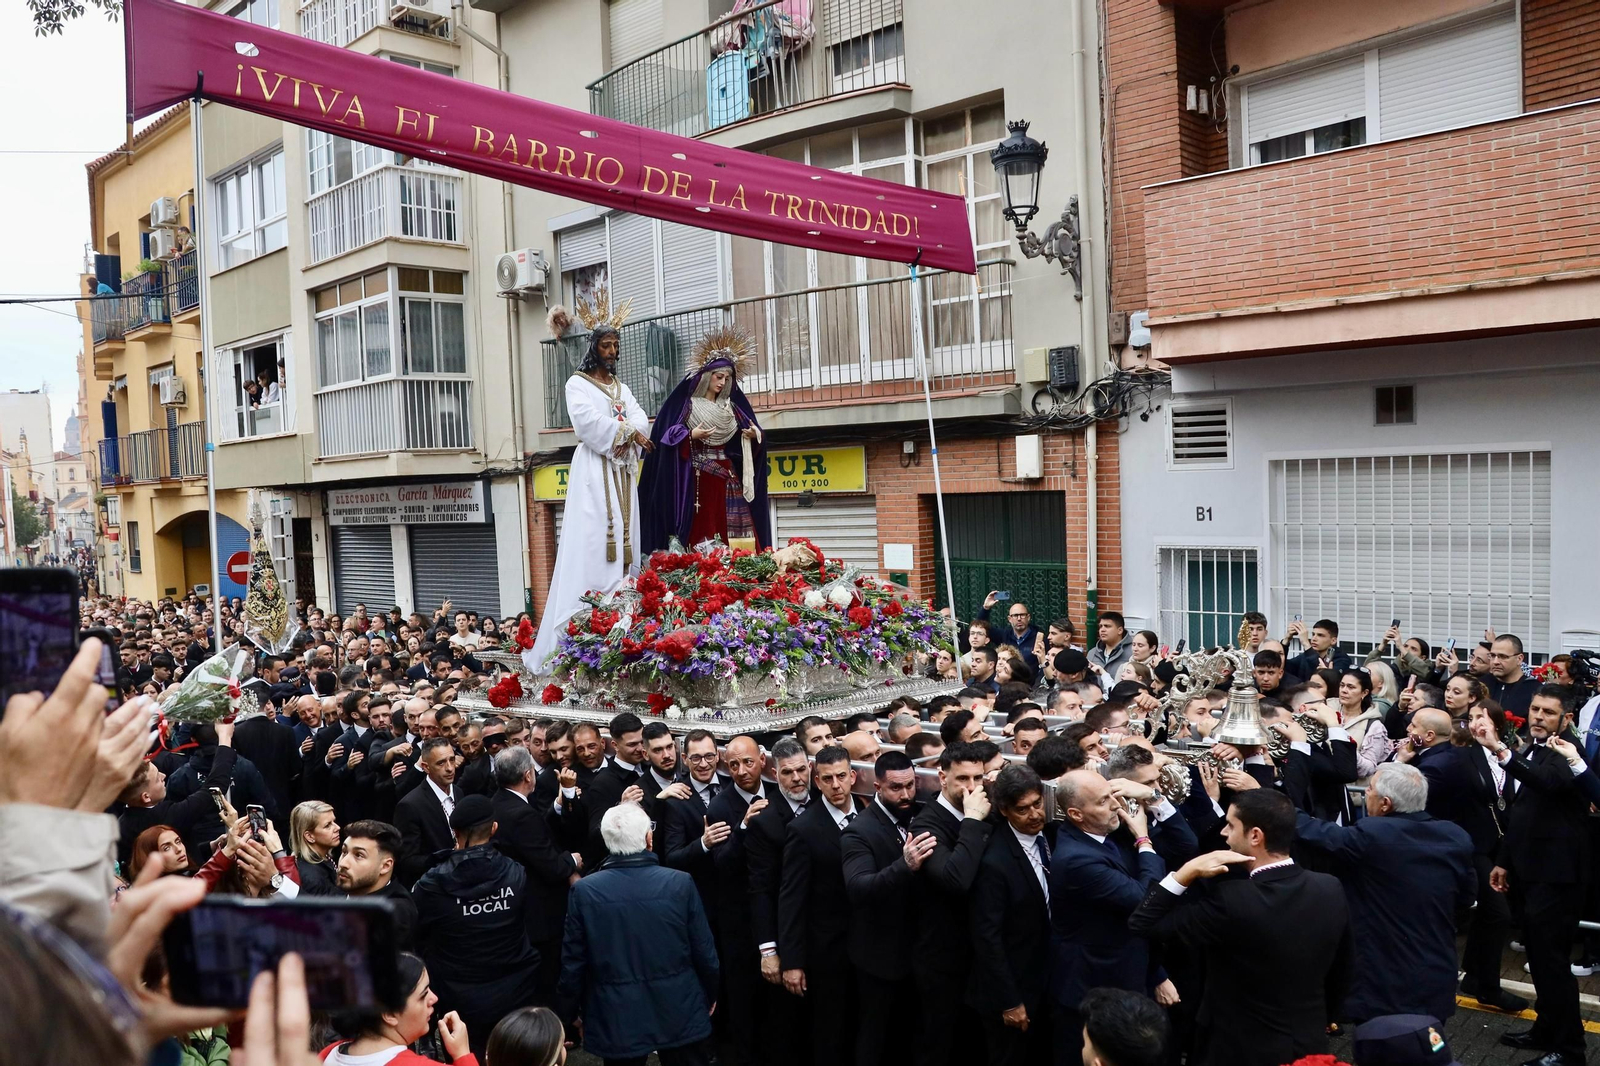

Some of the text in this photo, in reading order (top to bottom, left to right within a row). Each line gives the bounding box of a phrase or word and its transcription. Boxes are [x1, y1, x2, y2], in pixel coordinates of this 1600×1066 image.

[235, 63, 920, 239] ¡VIVA EL BARRIO DE LA TRINIDAD!
[782, 478, 829, 488] 100 Y 300
[335, 492, 391, 505] ELECTRONICA
[397, 486, 428, 502] García
[404, 505, 424, 514] SONIDO
[432, 503, 480, 512] AMPLIFICADORES
[1196, 506, 1212, 521] B1
[463, 899, 510, 916] LOCAL
